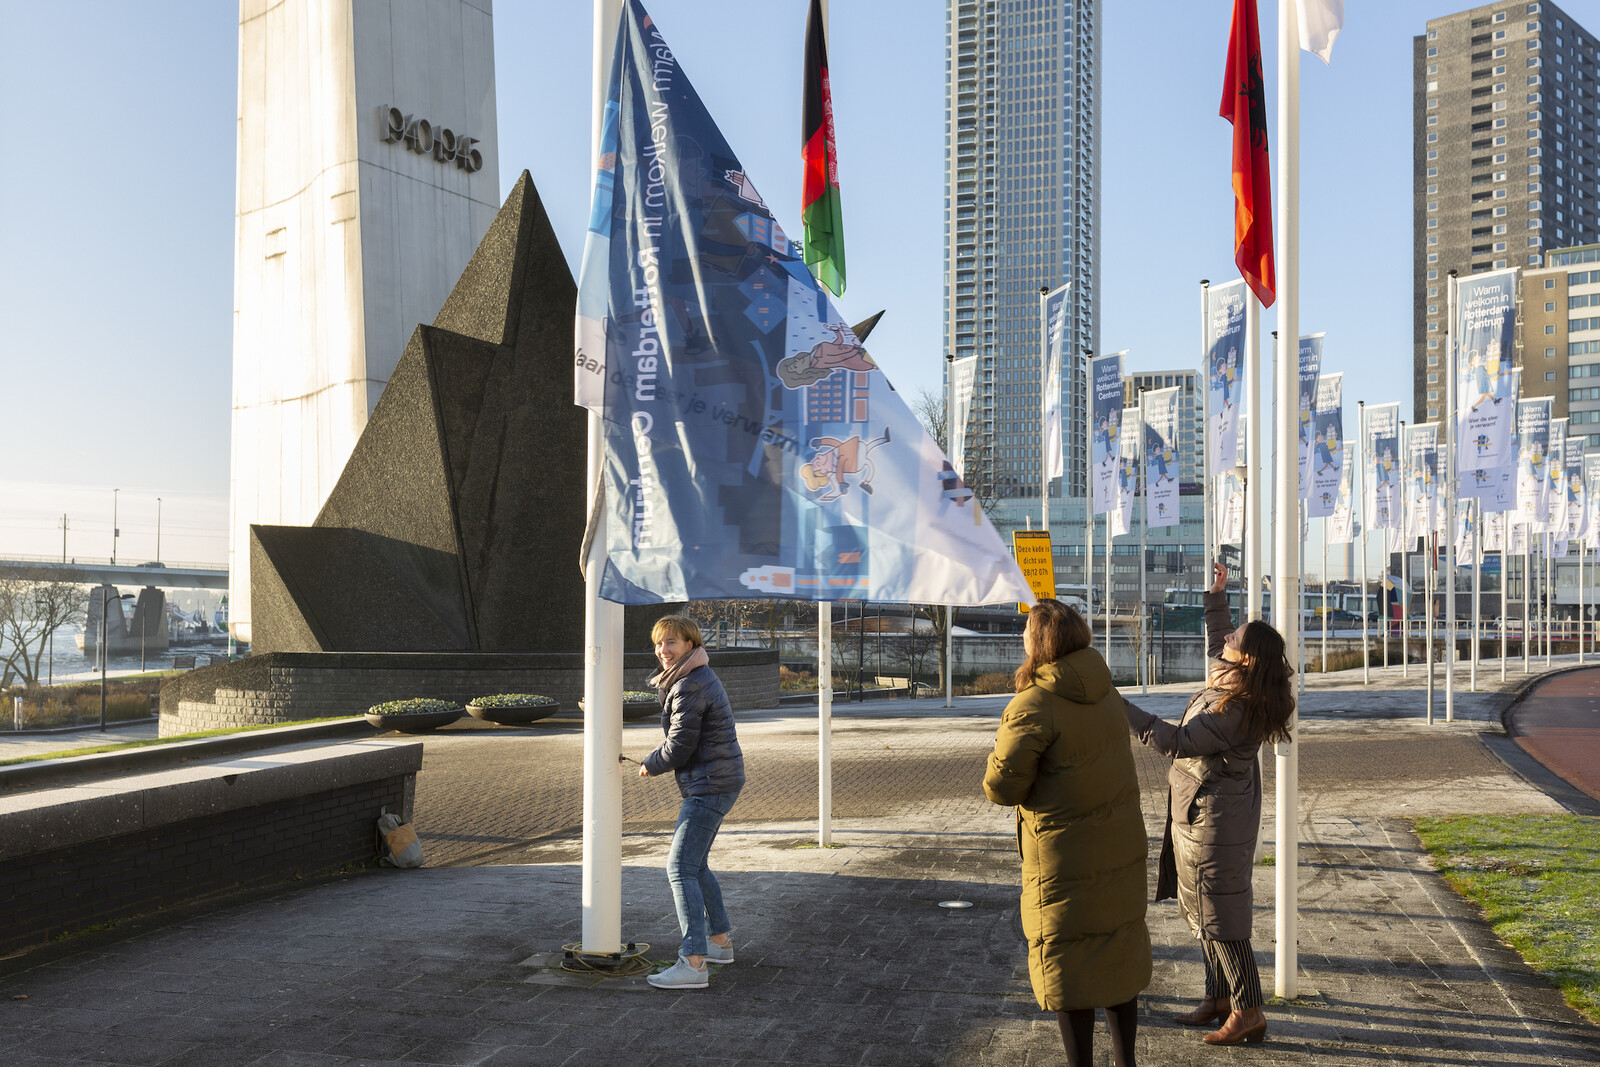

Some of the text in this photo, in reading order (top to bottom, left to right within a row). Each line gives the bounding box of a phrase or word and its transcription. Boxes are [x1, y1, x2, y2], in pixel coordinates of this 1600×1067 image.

[1473, 285, 1500, 296] Warm
[1465, 293, 1508, 309] welkom in
[1464, 305, 1510, 320] Rotterdam
[1467, 316, 1504, 330] Centrum
[576, 347, 607, 376] aar
[1101, 364, 1118, 373] Warm
[1096, 373, 1116, 383] welkom
[1096, 381, 1124, 392] Rotterdam
[1098, 390, 1120, 400] Centrum
[1024, 569, 1037, 577] 28/12
